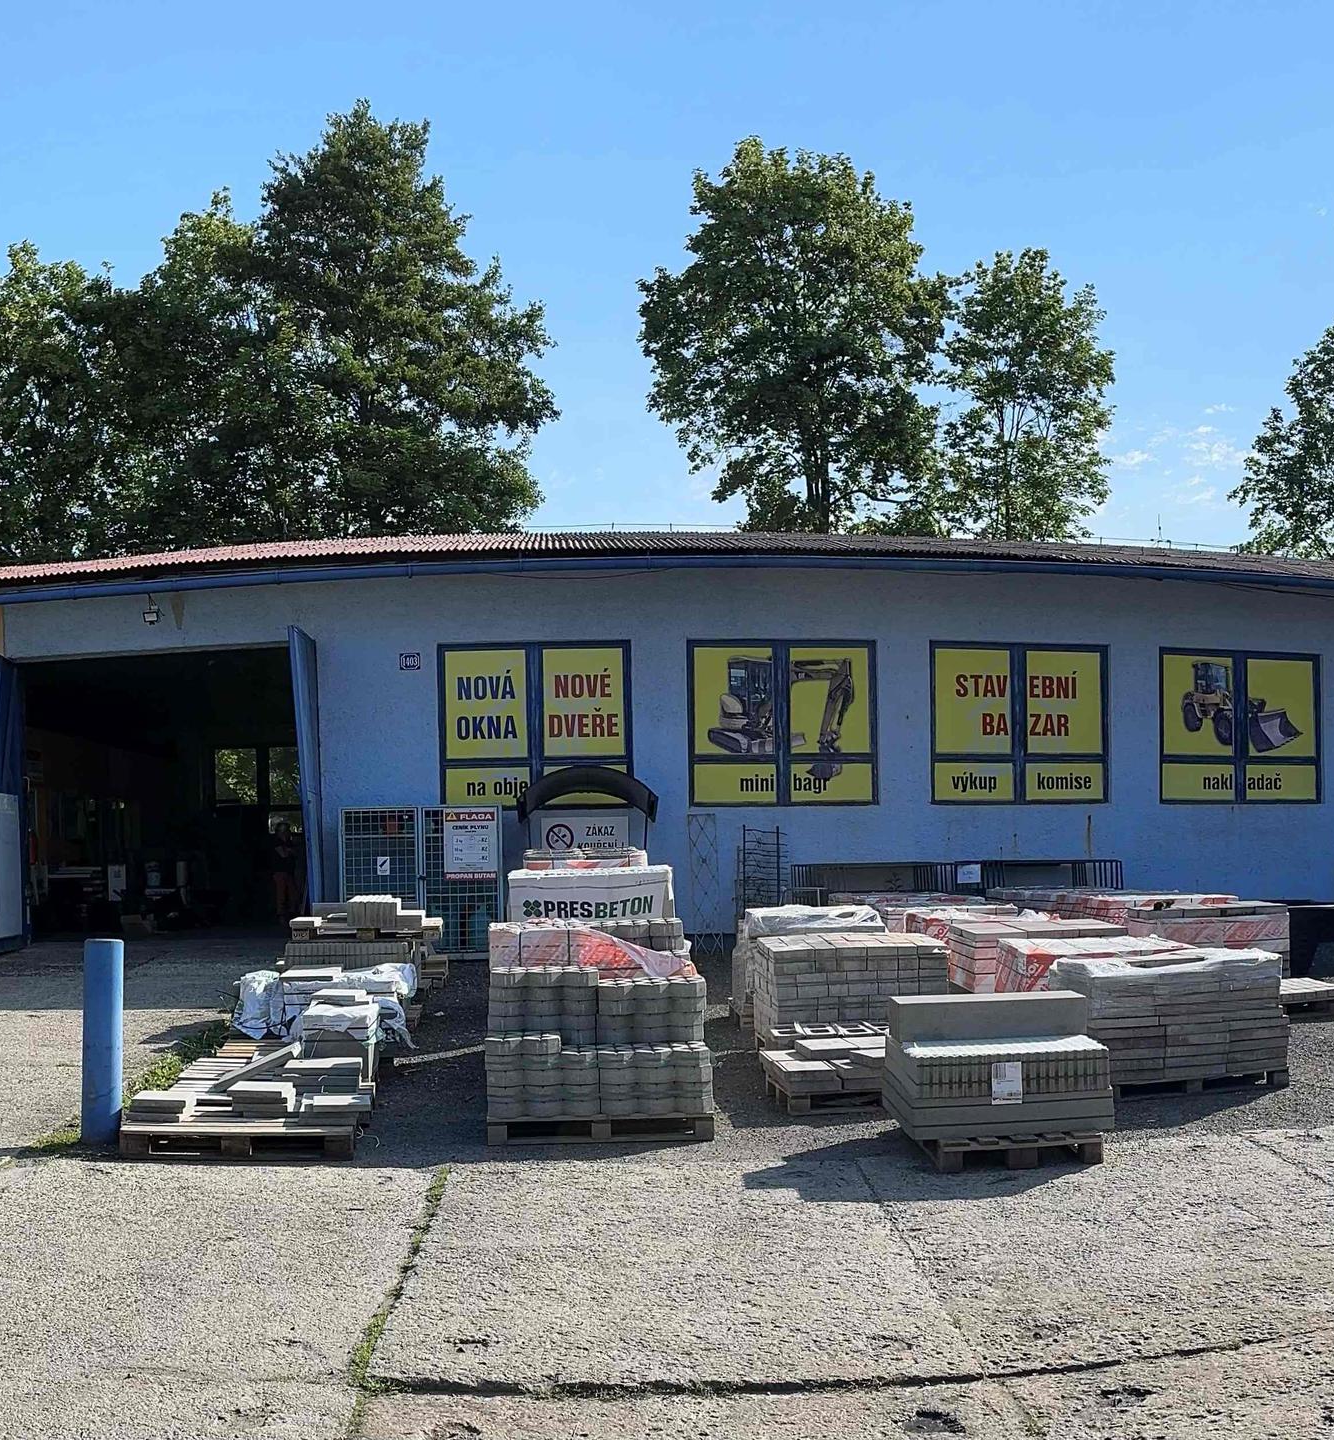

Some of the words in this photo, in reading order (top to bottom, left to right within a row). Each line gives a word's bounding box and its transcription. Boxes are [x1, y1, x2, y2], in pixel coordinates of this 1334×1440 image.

[402, 657, 418, 667] 1403
[456, 669, 516, 701] NOVÁ
[554, 668, 612, 699] NOVÉ
[456, 714, 518, 741] OKNA
[548, 708, 620, 739] DVEŘE
[467, 781, 486, 796] na
[494, 777, 529, 799] obje
[952, 772, 997, 793] výkup
[1036, 772, 1092, 791] komise
[585, 823, 615, 837] ZÁKAZ
[543, 895, 654, 919] PRESBETON
